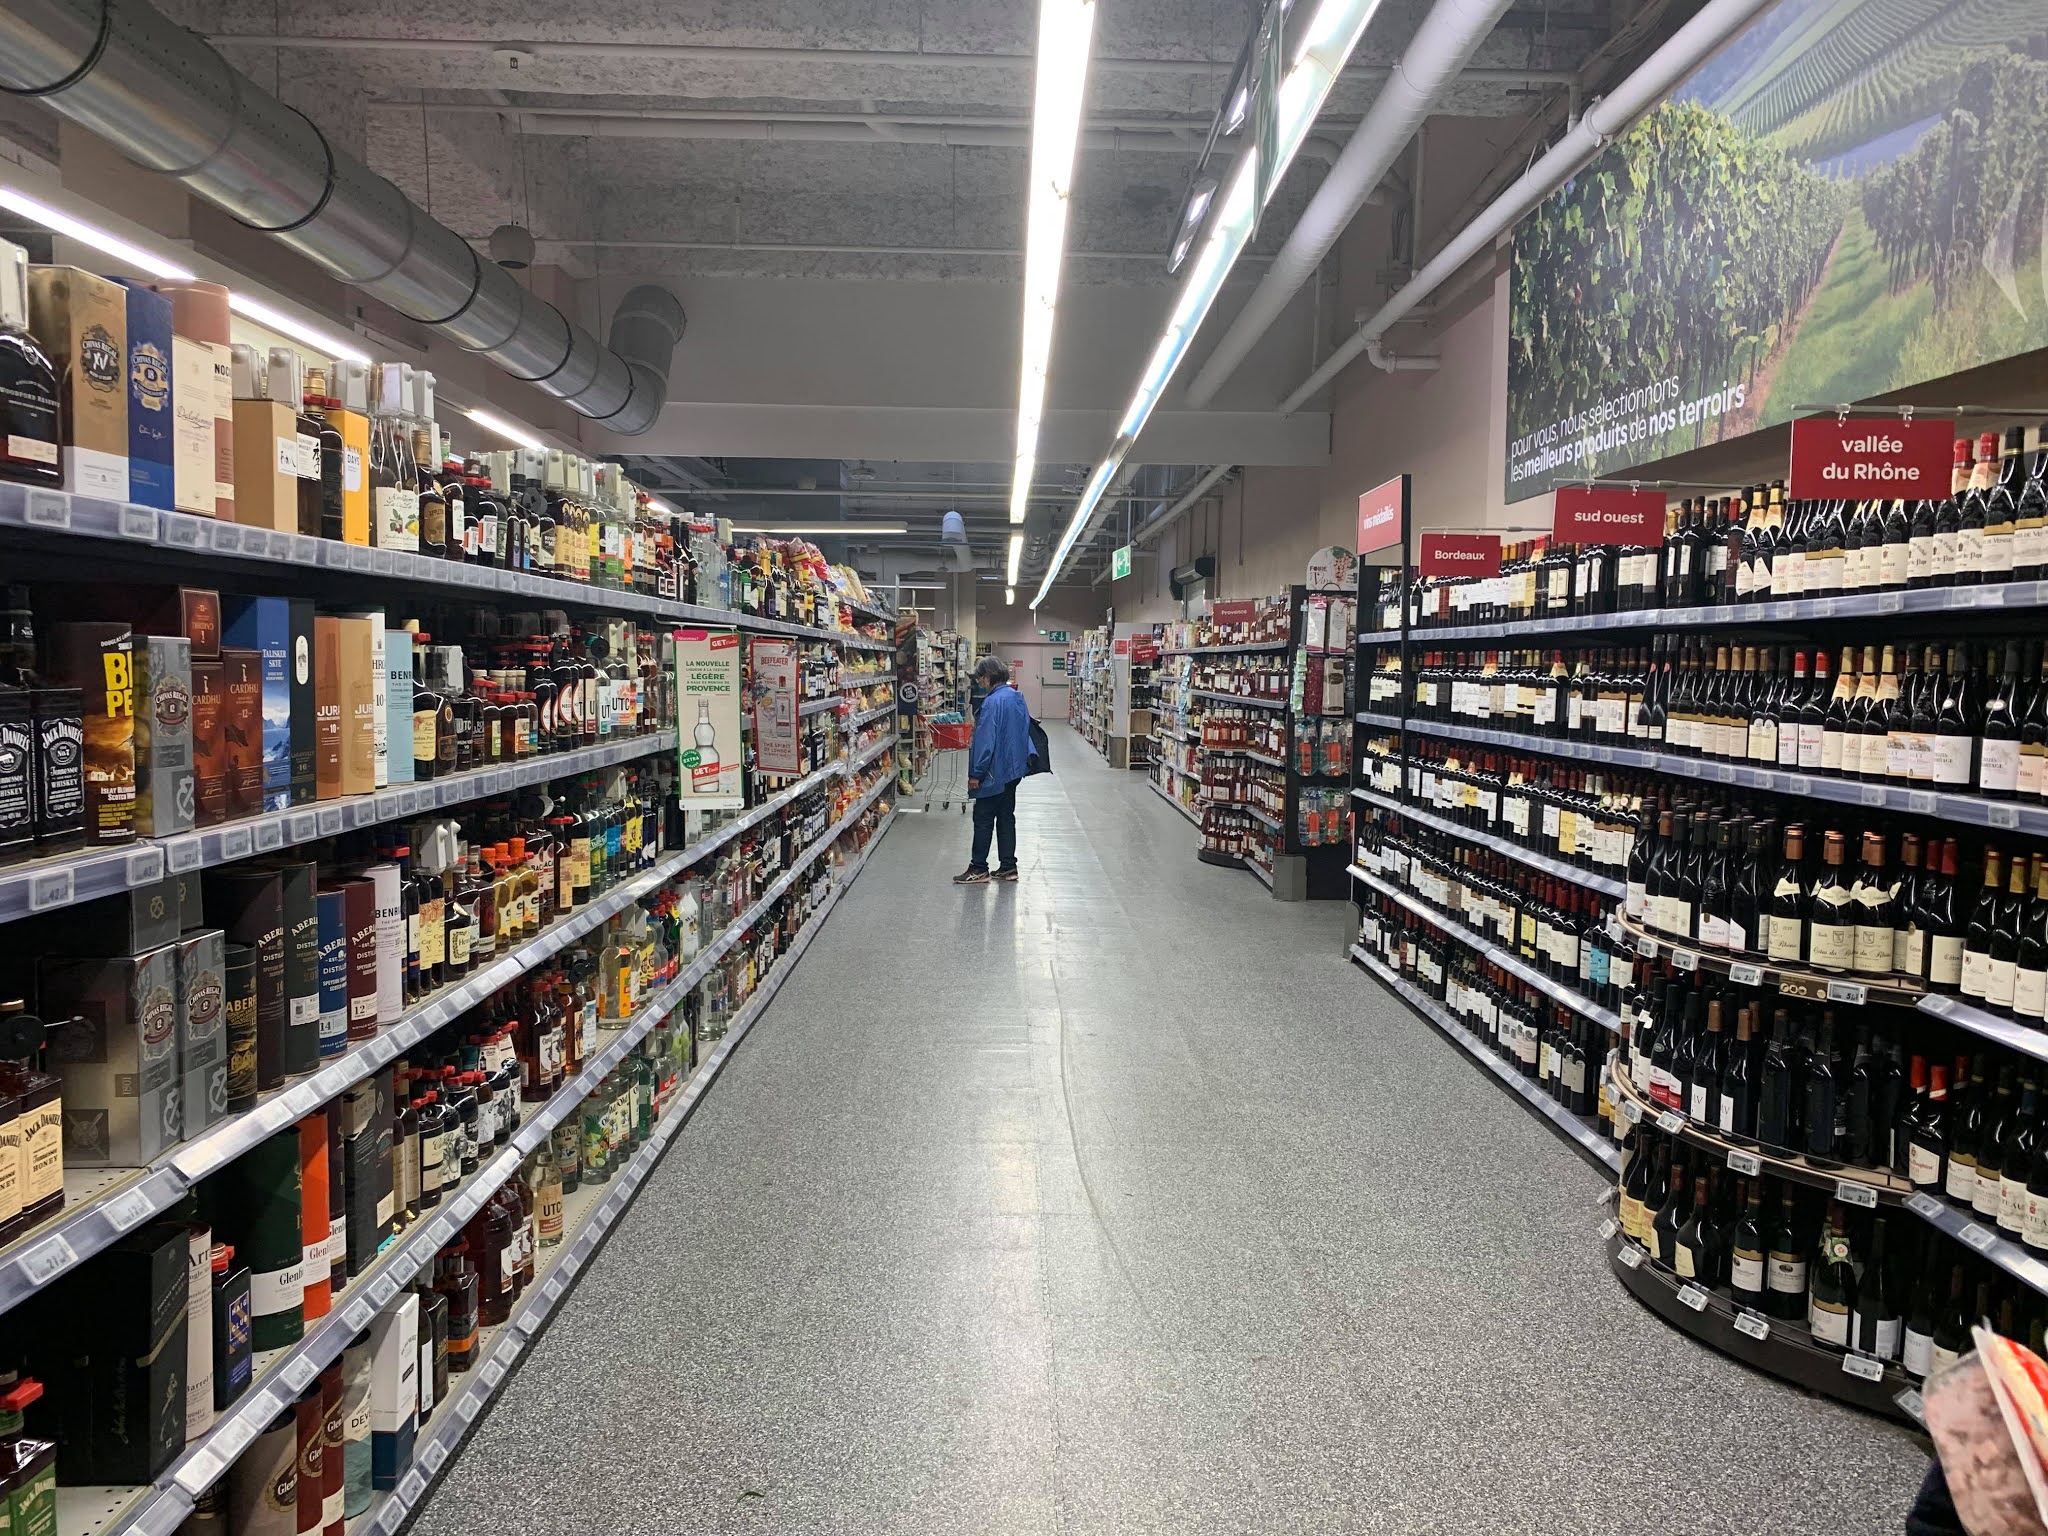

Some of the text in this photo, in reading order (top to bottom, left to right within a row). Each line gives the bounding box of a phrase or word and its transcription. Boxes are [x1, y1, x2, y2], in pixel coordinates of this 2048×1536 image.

[1511, 375, 1680, 458] pour vous, nous sélectionnons
[1511, 380, 1746, 483] les meilleurs produits de nos terroirs
[1842, 435, 1904, 454] vallée
[347, 454, 360, 466] DAYS
[1822, 463, 1920, 481] du Rhône
[1574, 508, 1645, 524] sud ouest
[1434, 550, 1486, 561] Bordeaux
[1221, 608, 1248, 616] Provence
[711, 639, 726, 647] GET
[262, 649, 287, 658] TALISKER
[761, 656, 789, 666] BEEFEATER
[230, 683, 260, 695] CARDHU
[192, 694, 222, 705] CARDHU
[329, 723, 337, 733] 10
[3, 727, 31, 752] DANIEL'S
[41, 721, 83, 750] JACK DANIEL'S
[683, 756, 700, 764] EXTRA
[50, 766, 79, 777] Tennessee
[694, 767, 709, 775] GET
[50, 779, 79, 789] WHISKEY
[100, 787, 117, 795] ISLAY
[189, 988, 206, 1006] CHIVAS
[143, 1007, 160, 1025] CHIVAS
[354, 1005, 366, 1015] 12
[320, 1022, 331, 1032] 14
[25, 1121, 41, 1142] JACK
[32, 1155, 58, 1173] HONEY
[231, 1299, 247, 1316] HAIG
[231, 1316, 248, 1333] CLUB
